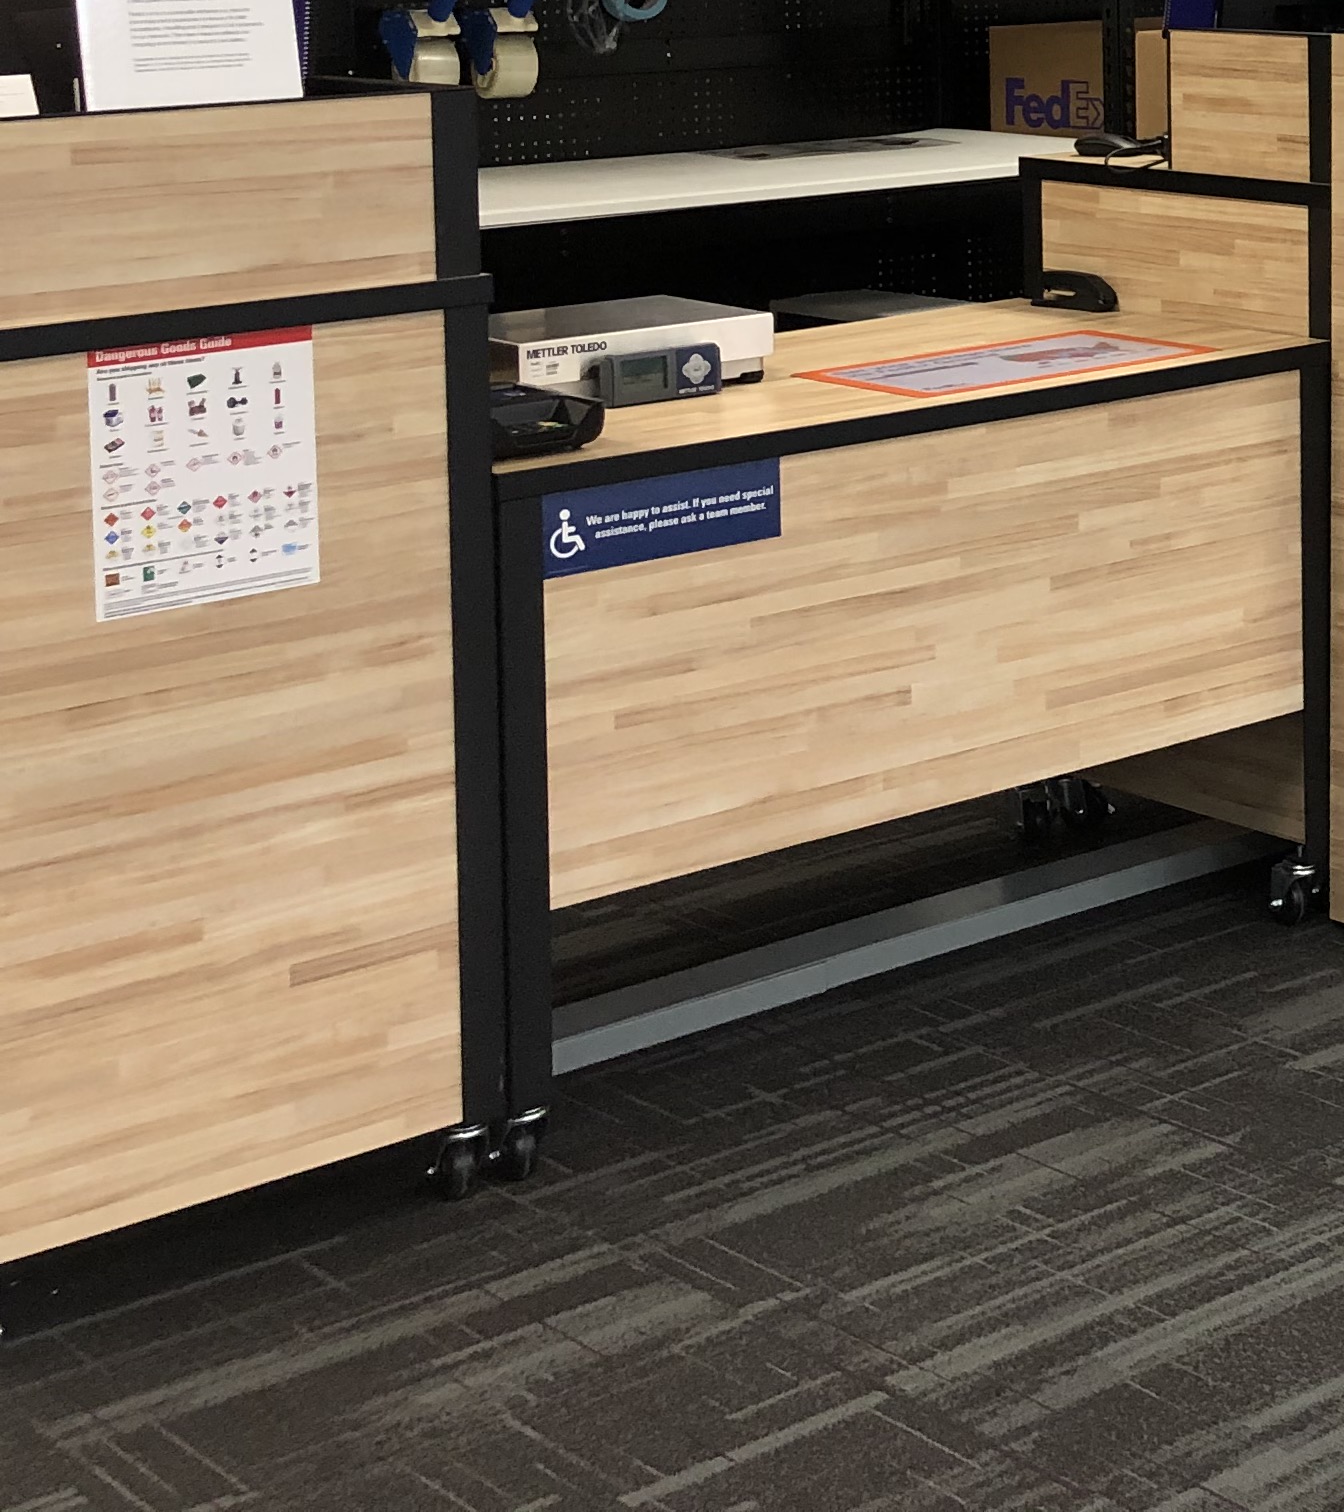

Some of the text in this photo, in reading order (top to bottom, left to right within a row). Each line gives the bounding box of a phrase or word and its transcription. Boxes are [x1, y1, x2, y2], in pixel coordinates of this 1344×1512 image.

[95, 336, 233, 363] Dangerous Goods Guide
[527, 341, 607, 360] METTLER TOLEDO
[586, 485, 774, 526] We are happy to assist. If you need special
[595, 502, 767, 539] assistance, please ask a team member.
